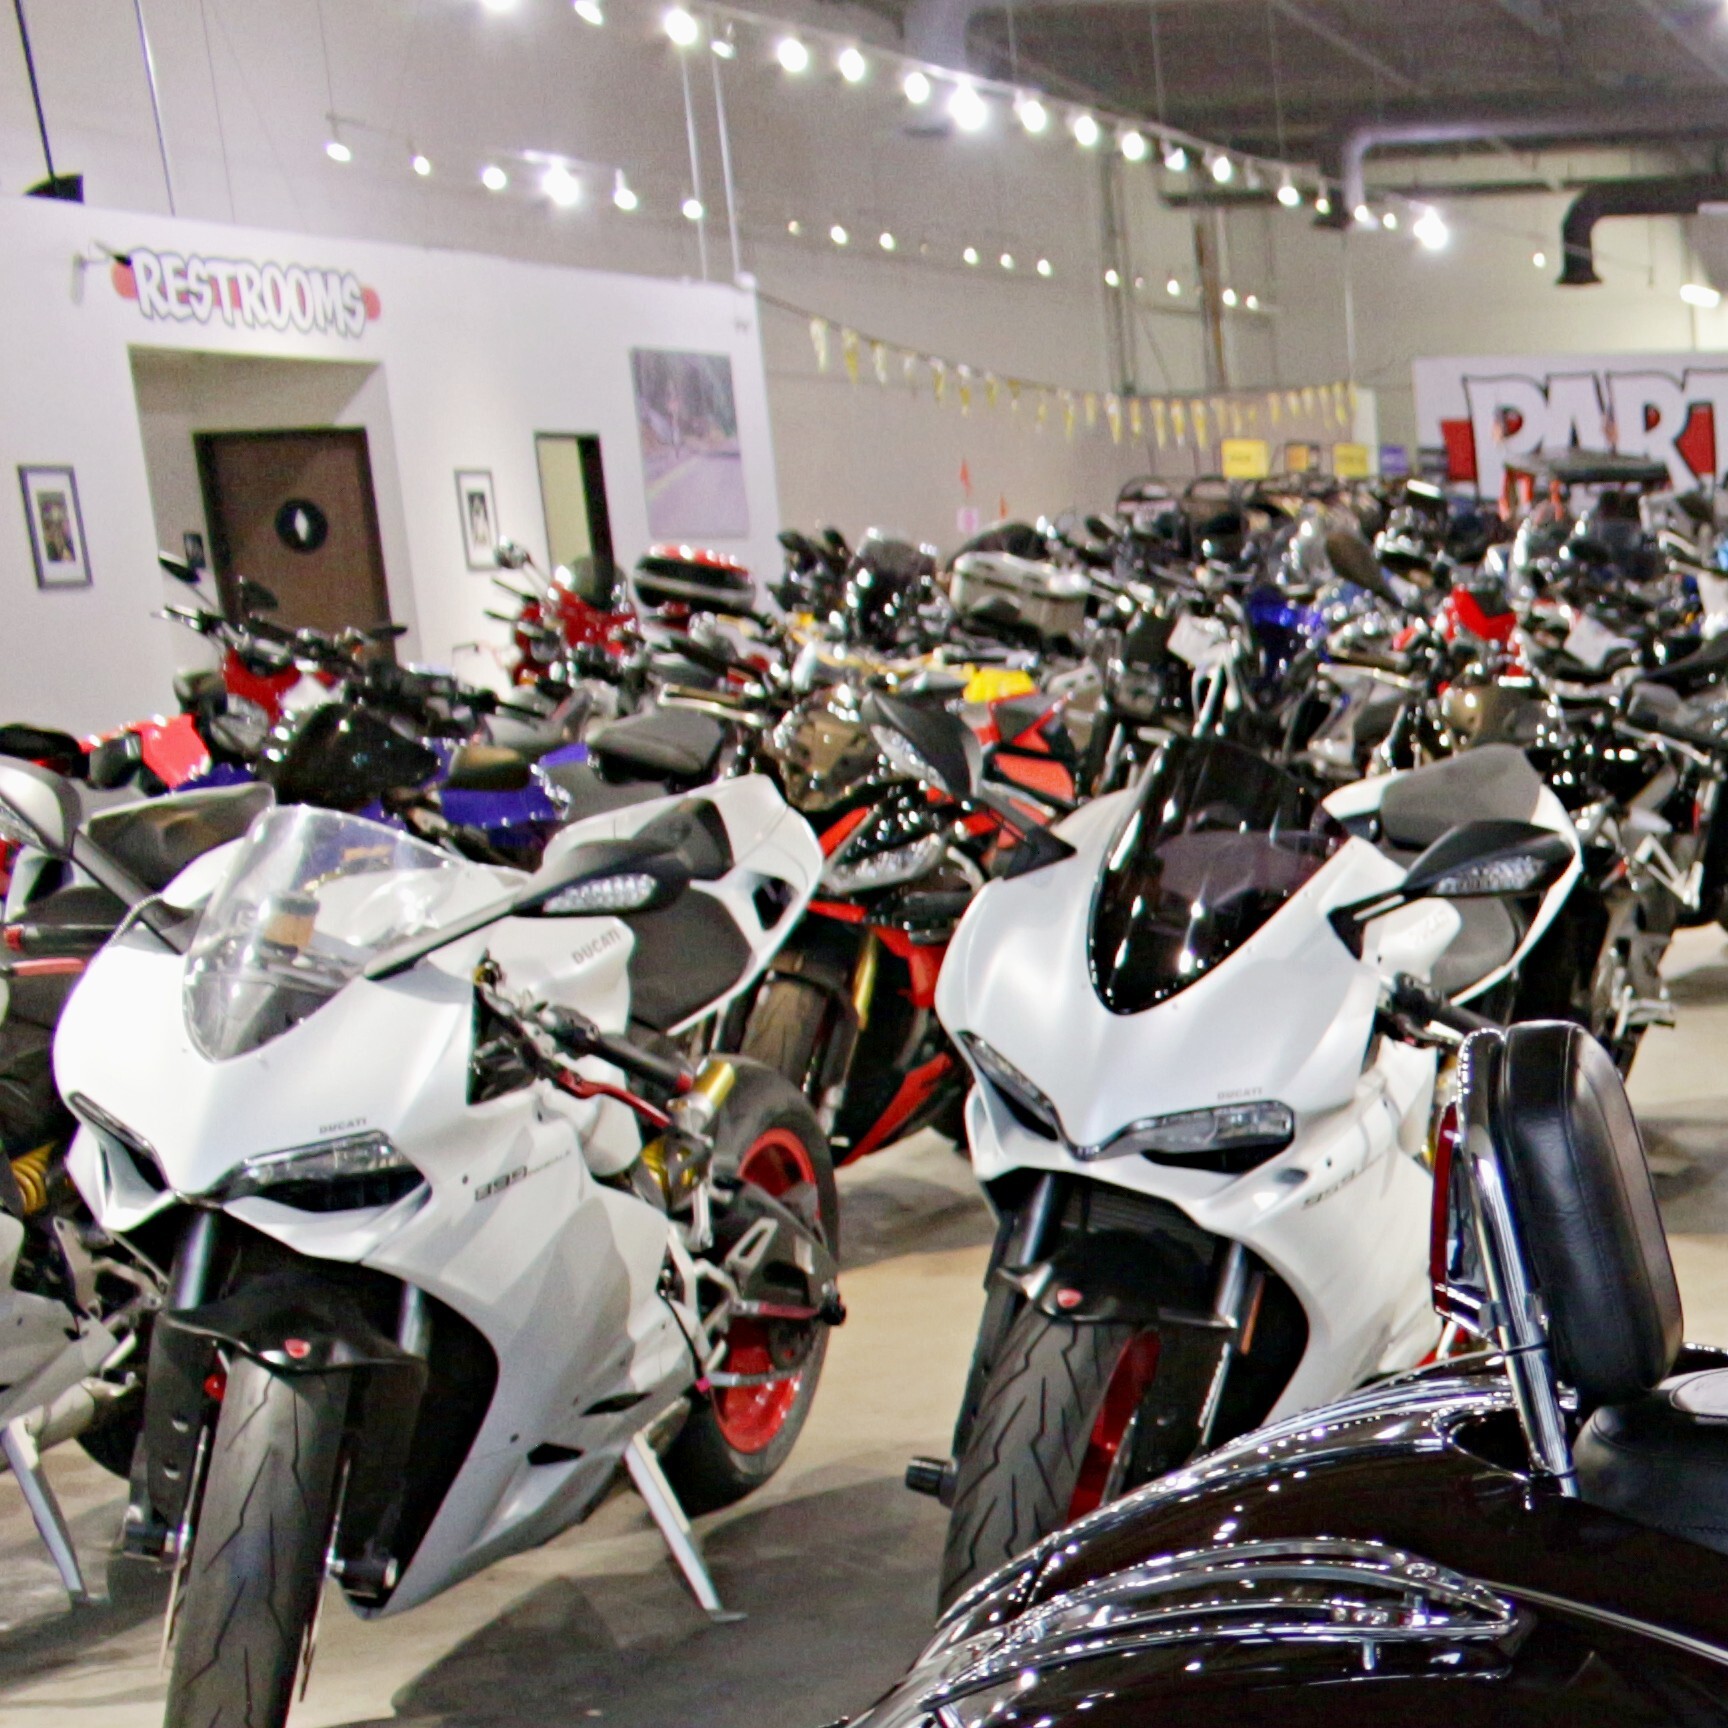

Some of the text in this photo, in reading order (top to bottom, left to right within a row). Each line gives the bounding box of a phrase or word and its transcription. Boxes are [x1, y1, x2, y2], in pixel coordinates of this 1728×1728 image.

[130, 247, 366, 337] RESTROOMS
[571, 927, 621, 965] DUCATI
[318, 1117, 368, 1135] DUCATI
